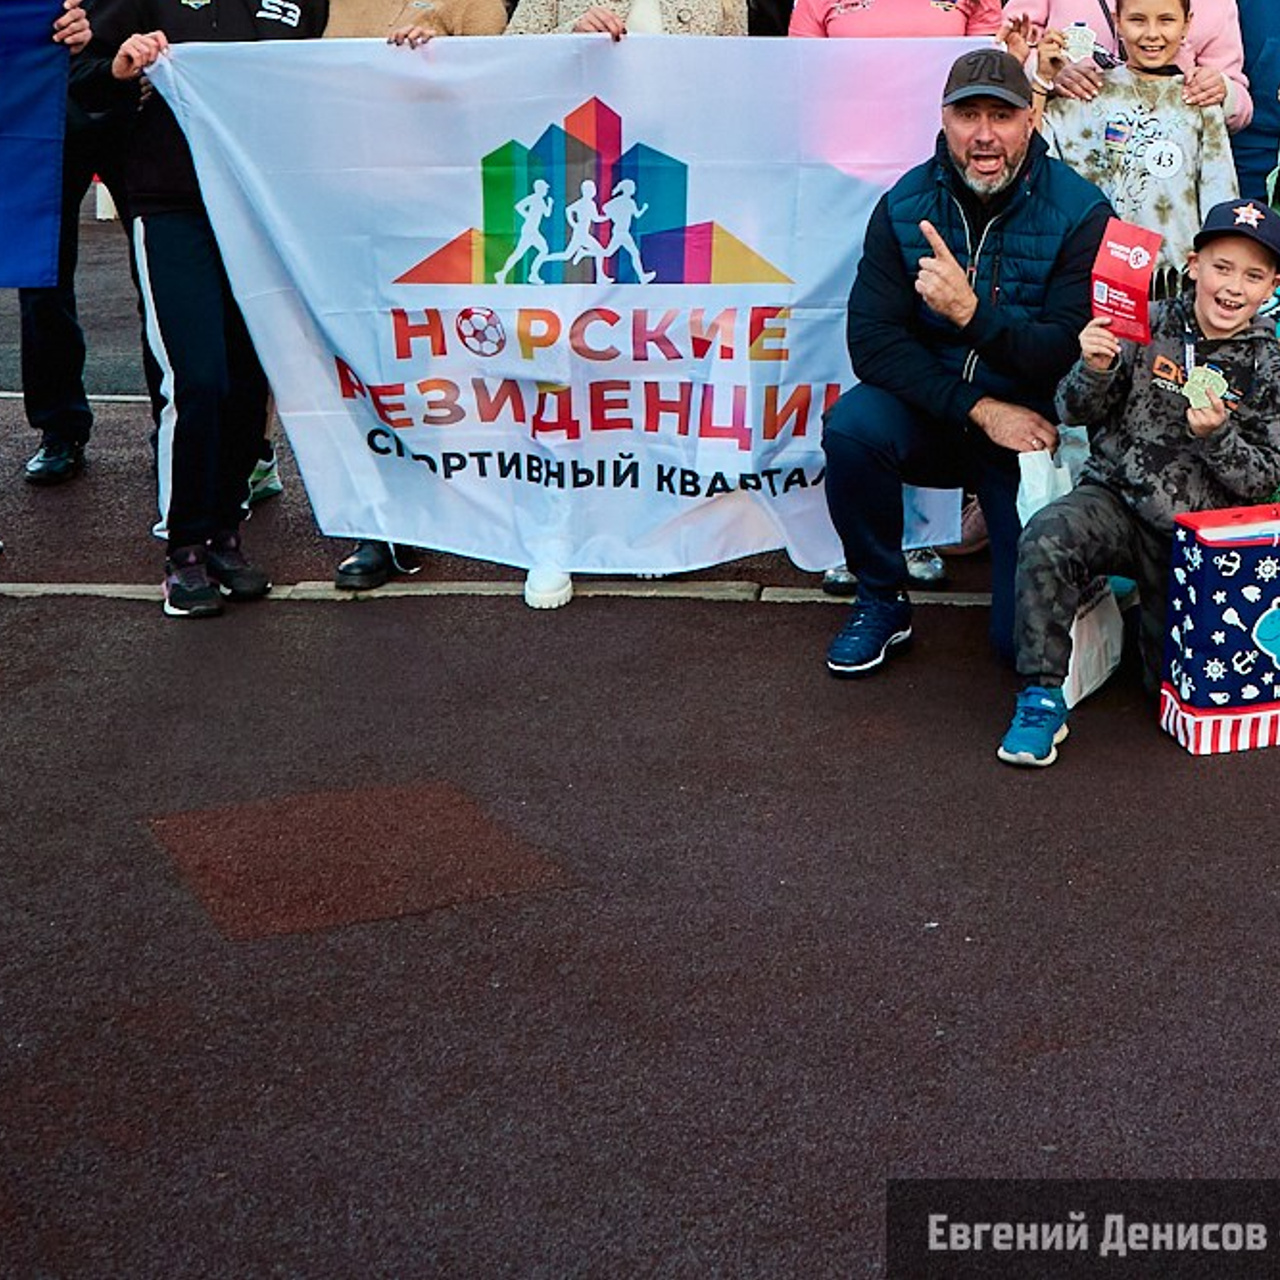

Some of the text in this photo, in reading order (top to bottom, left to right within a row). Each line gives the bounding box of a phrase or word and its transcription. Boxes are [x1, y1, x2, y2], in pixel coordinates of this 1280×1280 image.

[1152, 150, 1174, 168] 43
[391, 306, 792, 362] НОРСКИЕ
[334, 355, 841, 452] ЕЗИДЕНЦИ
